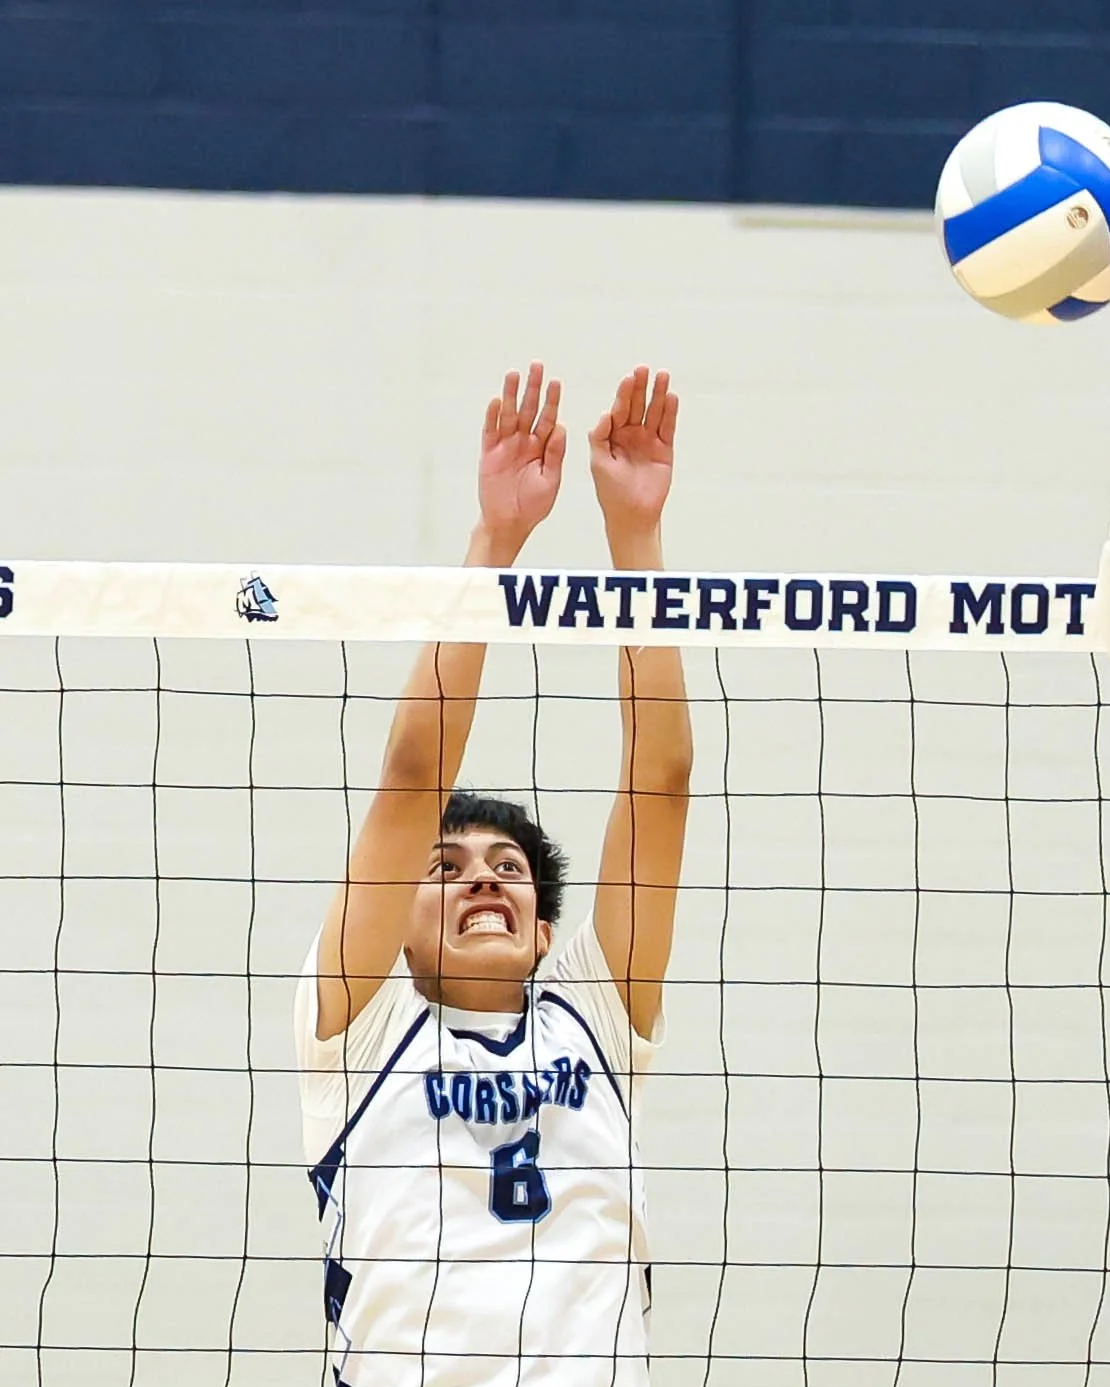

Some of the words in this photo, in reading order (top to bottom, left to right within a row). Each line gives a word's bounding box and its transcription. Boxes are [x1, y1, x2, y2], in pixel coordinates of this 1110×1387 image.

[498, 574, 917, 633] WATERFORD
[949, 582, 1097, 635] MOT
[488, 1127, 552, 1224] 6
